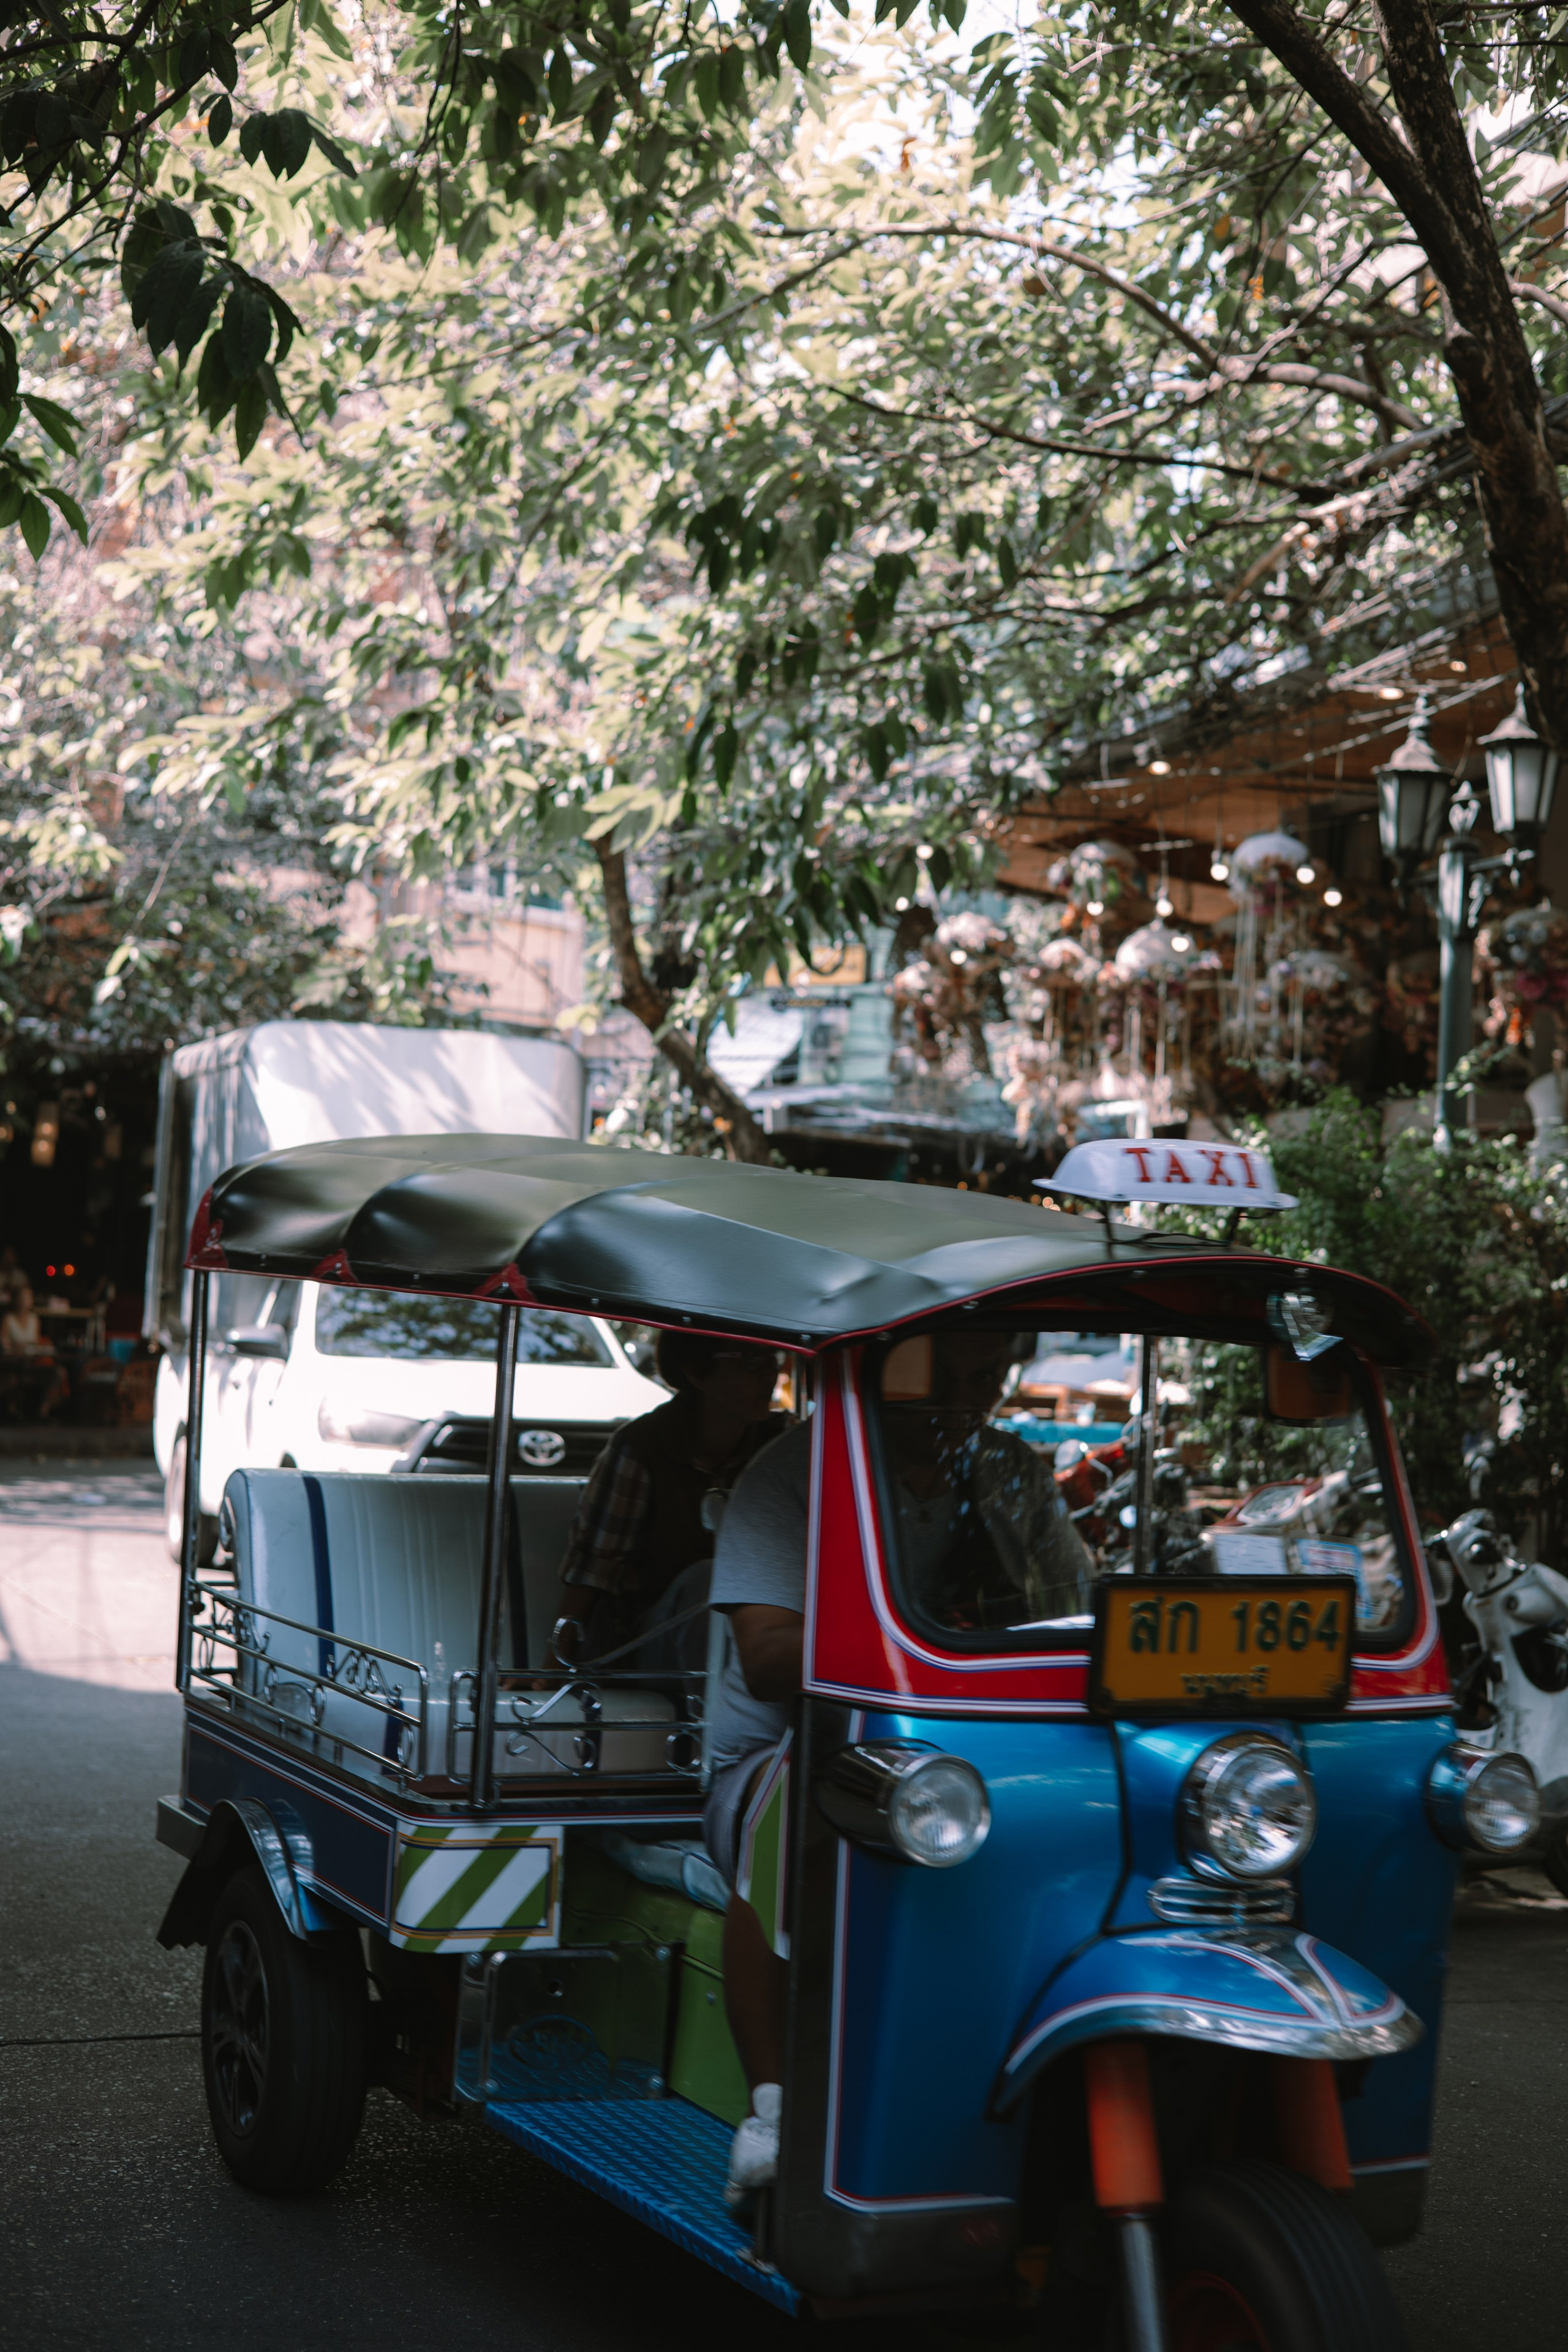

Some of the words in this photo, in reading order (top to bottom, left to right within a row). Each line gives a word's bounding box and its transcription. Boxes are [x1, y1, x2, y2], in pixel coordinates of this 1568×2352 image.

[1124, 1147, 1259, 1188] TAXI
[1128, 1595, 1199, 1653] สก
[1230, 1599, 1343, 1652] 1864
